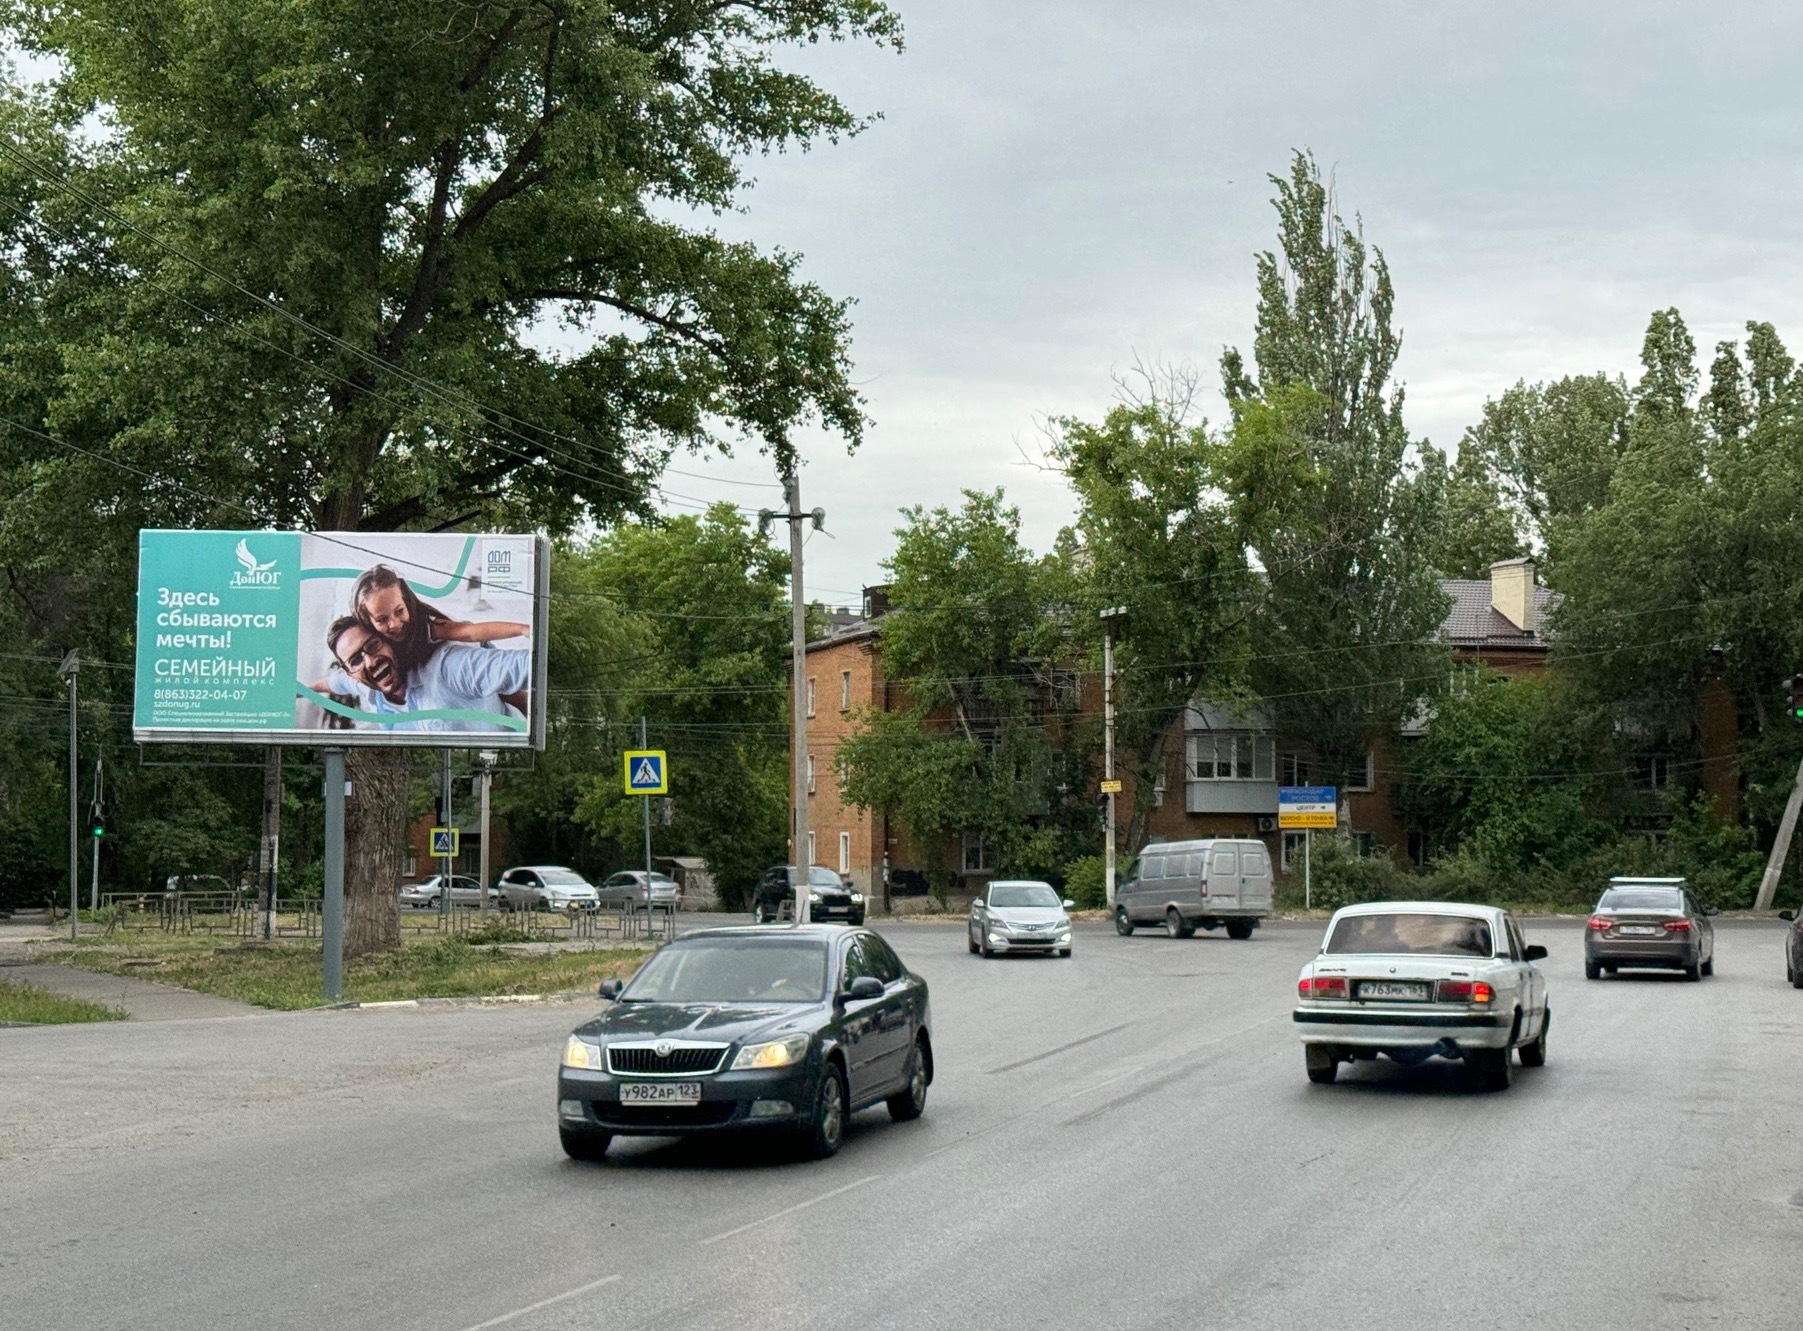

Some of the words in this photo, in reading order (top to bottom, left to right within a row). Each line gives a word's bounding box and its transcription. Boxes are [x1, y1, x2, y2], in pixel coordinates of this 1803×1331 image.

[487, 550, 511, 563] ДОМ
[229, 571, 282, 585] ДонЮГ
[157, 587, 221, 607] Здесь
[156, 608, 277, 628] сбываются
[155, 630, 232, 649] мечты!
[154, 656, 276, 677] СЕМЕЙНЫЙ
[154, 676, 200, 685] жилой
[204, 677, 276, 686] комплекс
[153, 689, 248, 700] 8(863)322-04-07
[153, 700, 201, 709] szdonug.ru
